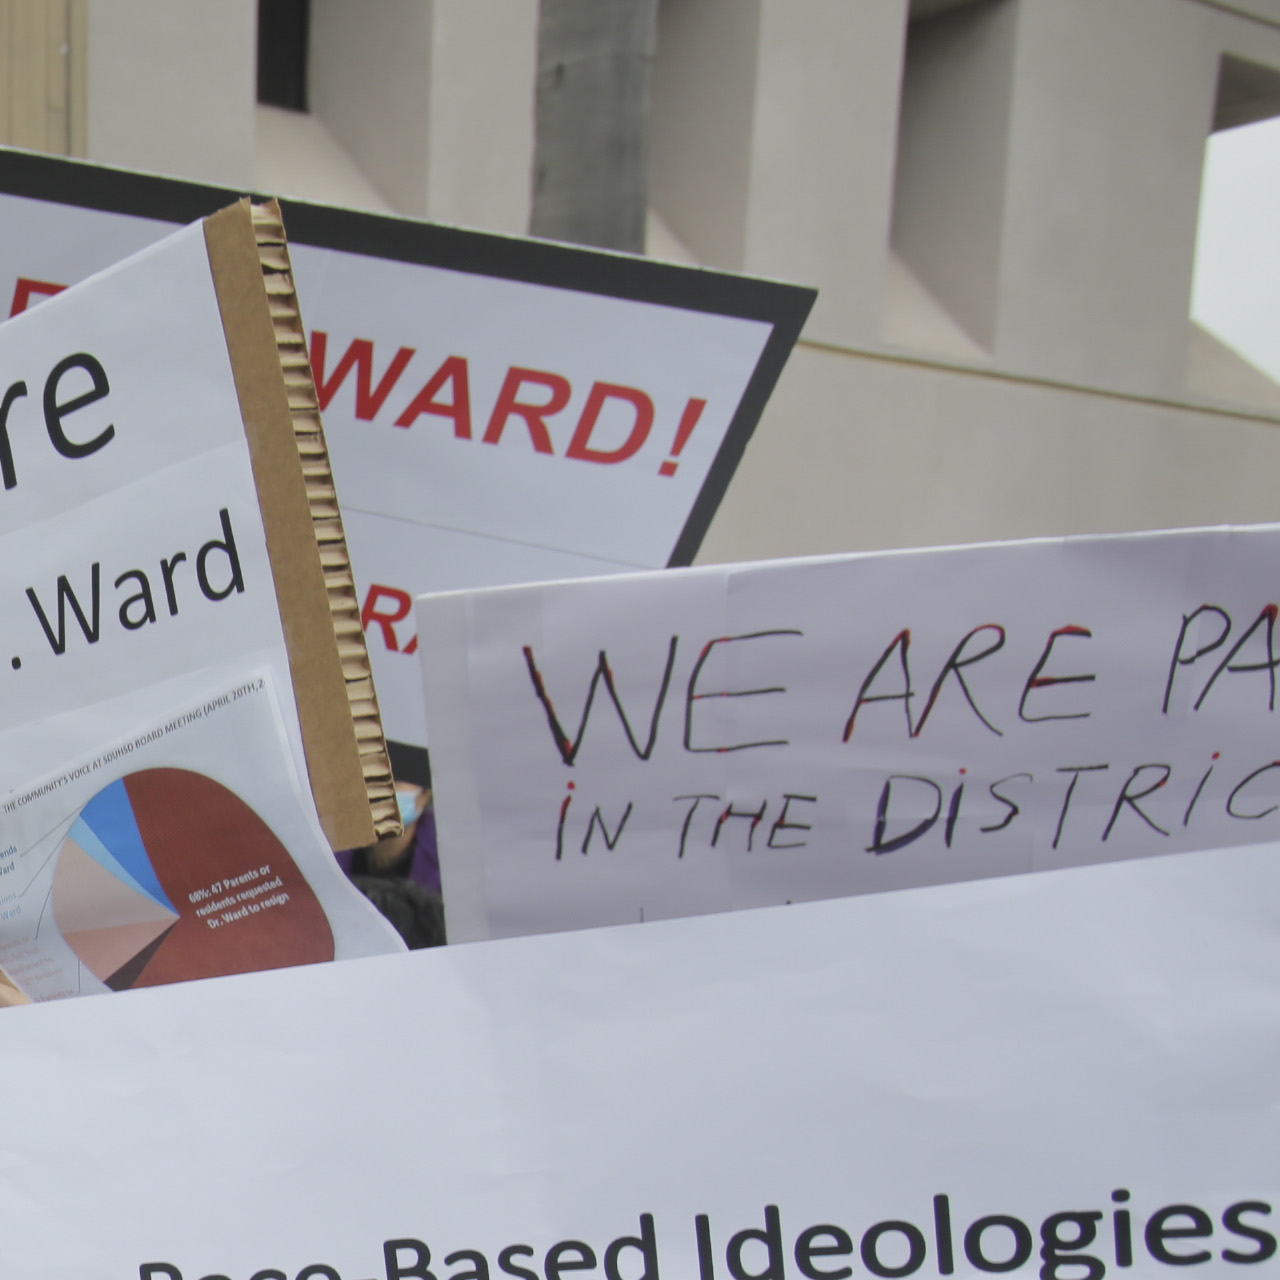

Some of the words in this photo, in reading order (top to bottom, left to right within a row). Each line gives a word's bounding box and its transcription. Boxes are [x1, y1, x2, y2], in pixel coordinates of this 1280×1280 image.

[305, 330, 708, 479] WARD!
[26, 508, 246, 658] Ward
[522, 629, 804, 766] WE
[842, 623, 1098, 742] ARE
[3, 802, 17, 814] THE
[68, 765, 90, 781] VOICE
[92, 758, 103, 771] AT
[135, 728, 164, 749] BOARD
[164, 709, 203, 734] MEETING
[203, 694, 231, 717] (APRIL
[672, 792, 817, 860] THE
[196, 896, 236, 917] residents
[236, 875, 283, 901] requested
[221, 906, 249, 923] Ward
[248, 904, 260, 913] to
[260, 893, 290, 909] resign
[223, 870, 259, 889] Parents
[260, 864, 270, 875] or
